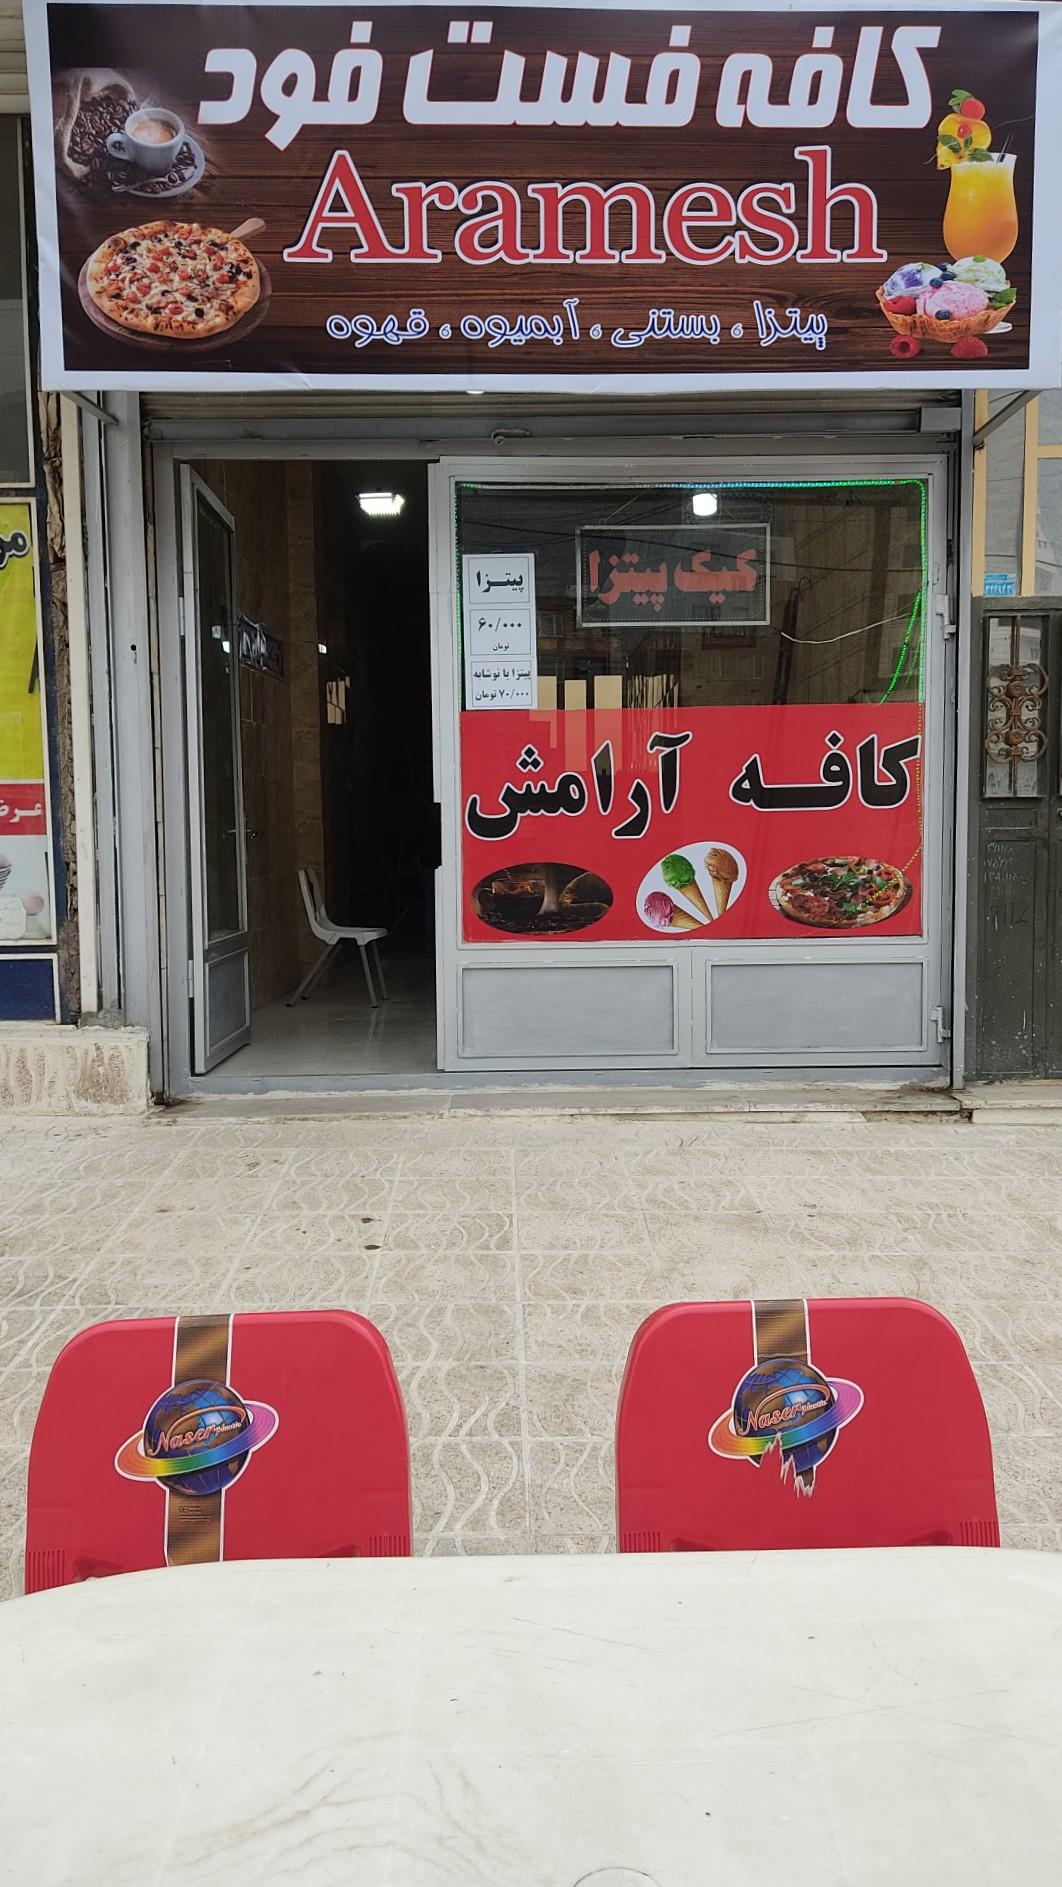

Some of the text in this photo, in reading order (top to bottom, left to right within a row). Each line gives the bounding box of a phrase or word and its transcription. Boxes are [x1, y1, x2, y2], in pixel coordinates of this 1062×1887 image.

[197, 21, 941, 151] کافه فست فود
[283, 145, 887, 265] Aramesh
[326, 308, 429, 348] قهوه
[460, 298, 580, 348] آبمیوه
[611, 308, 720, 348] بستنی
[753, 300, 828, 350] پیتزا
[476, 570, 524, 593] پیتزا
[588, 549, 757, 612] کیک پیتزا
[478, 616, 522, 632] ۶۰/۰۰۰
[492, 642, 510, 652] تومان
[473, 667, 531, 681] پیتزا با نوشابه
[475, 689, 497, 701] تومان
[464, 730, 922, 842] کافه آرامش
[738, 1403, 801, 1435] Naser
[147, 1424, 215, 1456] Naser
